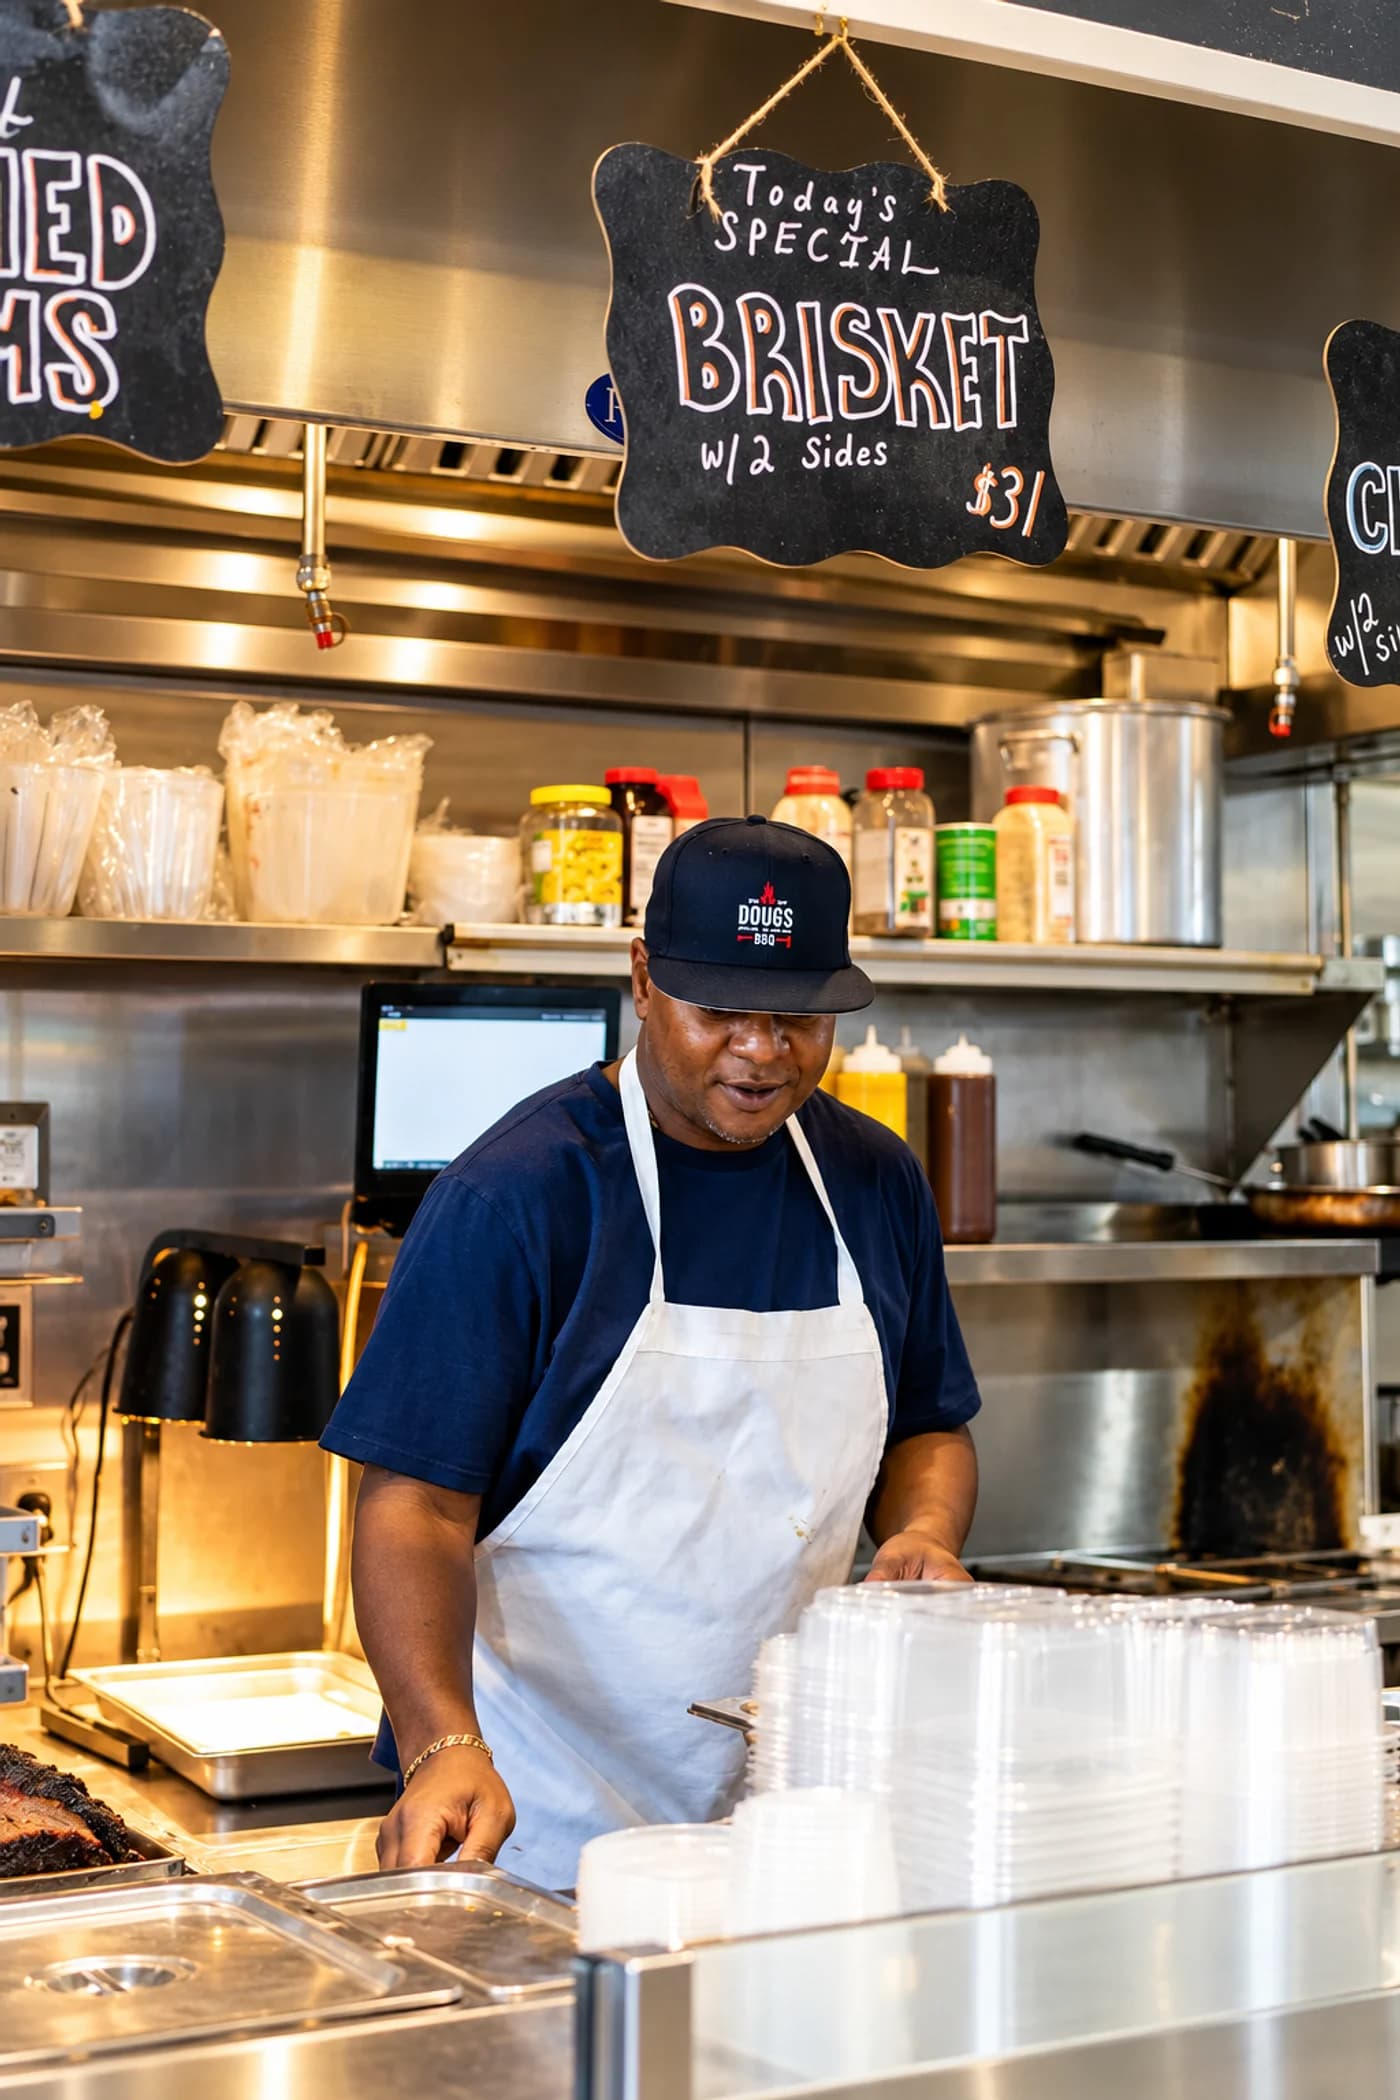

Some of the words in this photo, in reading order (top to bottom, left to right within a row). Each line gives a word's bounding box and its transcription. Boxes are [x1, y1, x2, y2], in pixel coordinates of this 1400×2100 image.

[733, 163, 898, 231] Today's
[714, 211, 940, 276] SPECIAL
[667, 282, 1030, 433] BRISKET
[738, 904, 794, 929] DOUGS
[754, 932, 775, 946] BBQ
